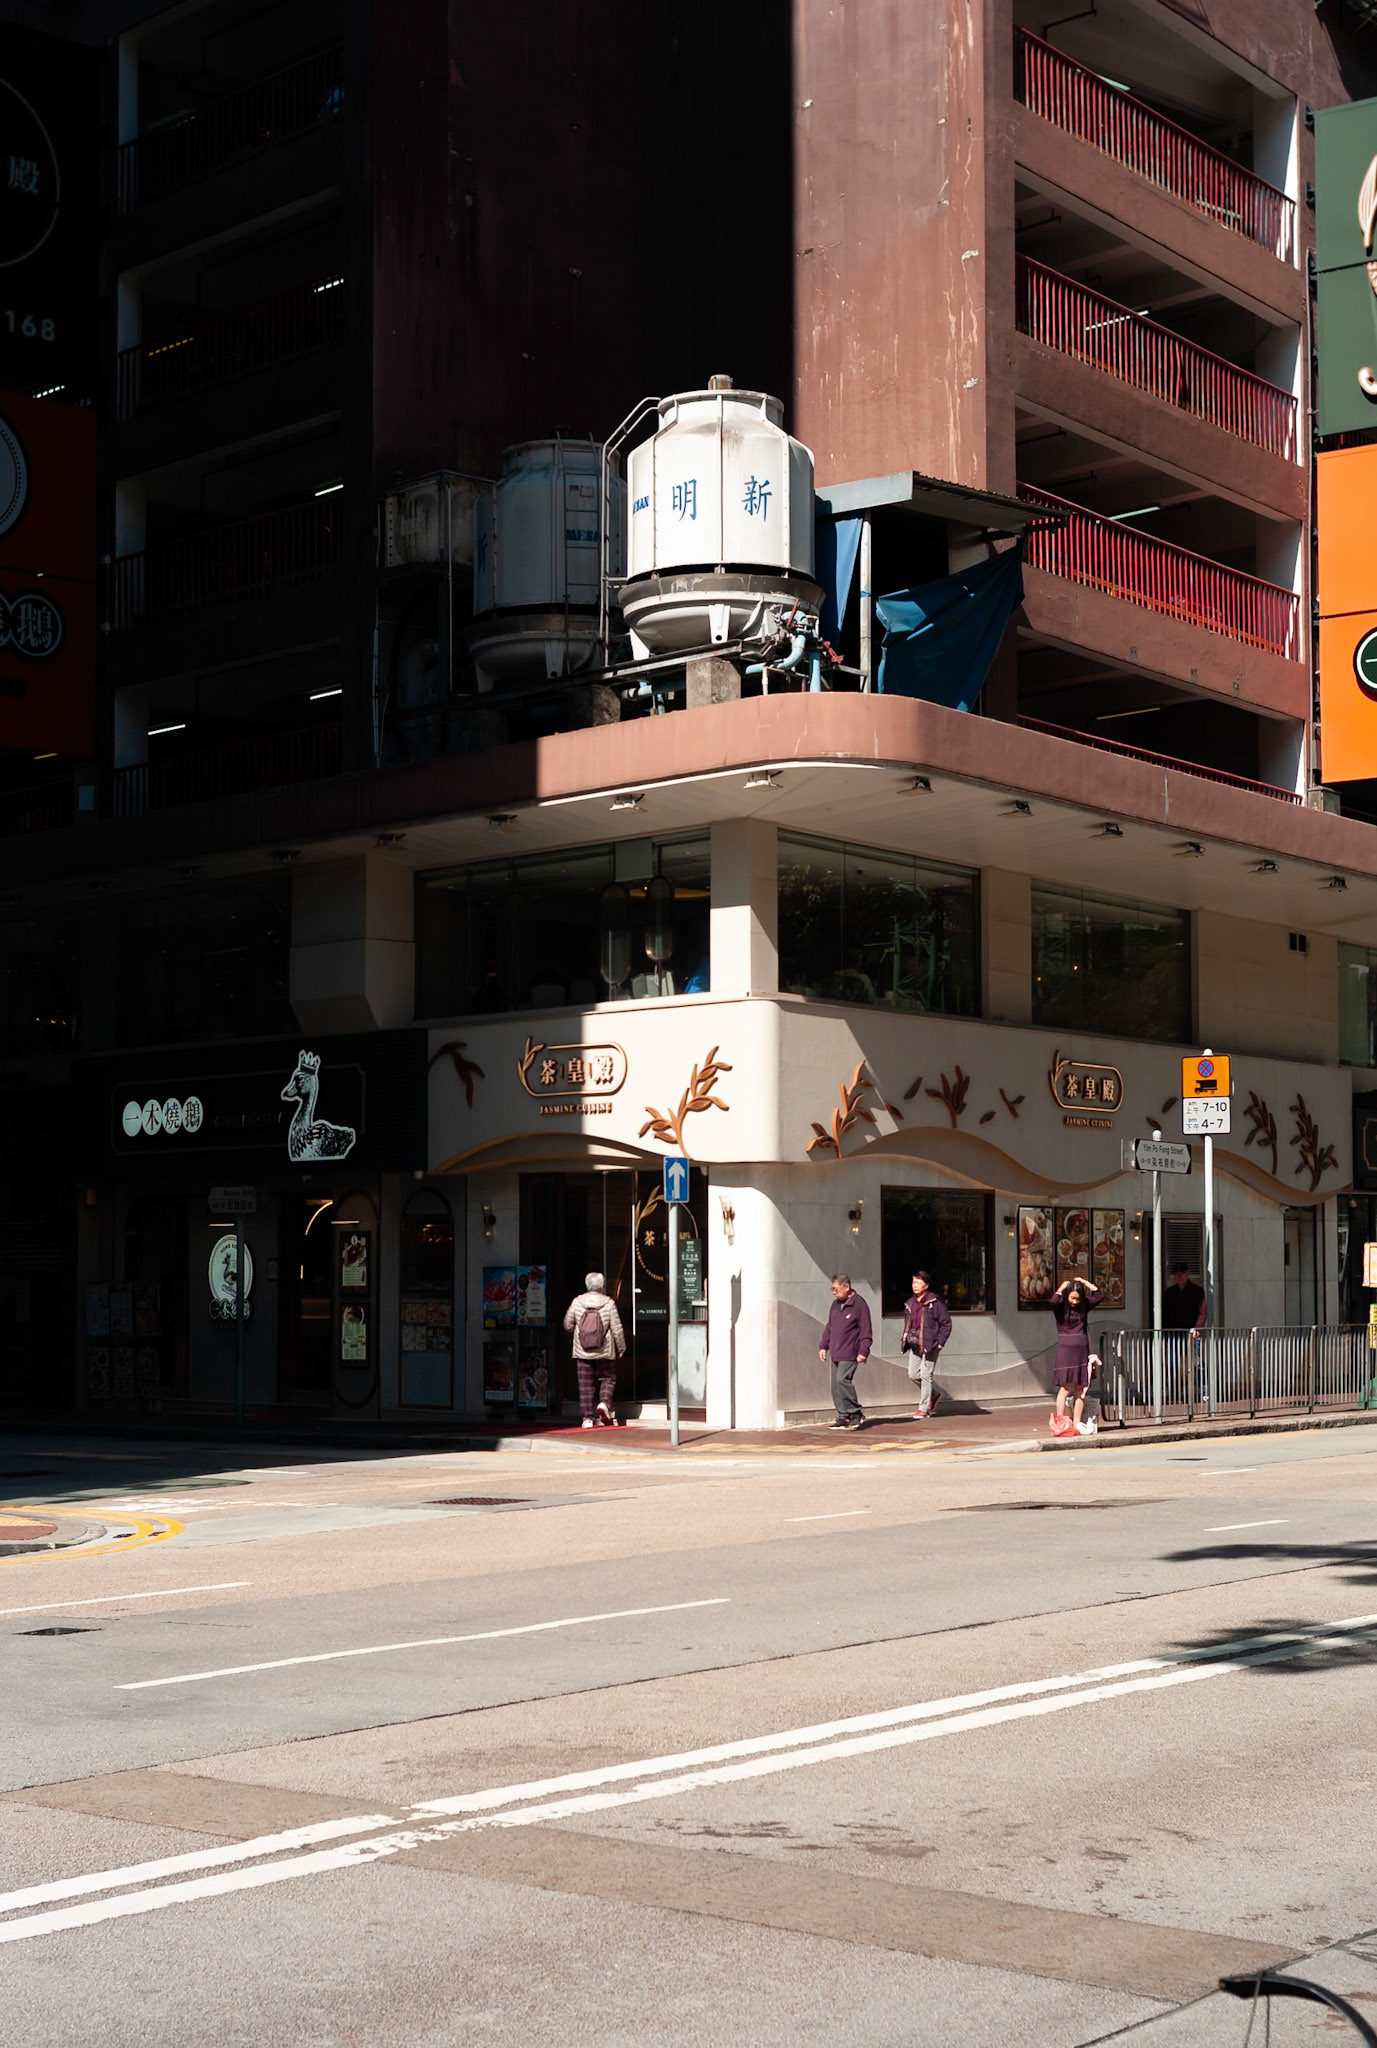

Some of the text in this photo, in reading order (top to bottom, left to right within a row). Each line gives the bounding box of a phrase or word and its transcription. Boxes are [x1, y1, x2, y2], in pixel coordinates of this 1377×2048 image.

[540, 1057, 614, 1085] 茶皇殿
[1065, 1074, 1115, 1102] 茶皇殿
[540, 1105, 575, 1115] JASMINE
[1202, 1102, 1227, 1112] 7-10
[1201, 1118, 1223, 1128] 4-7
[1170, 1146, 1184, 1155] Street
